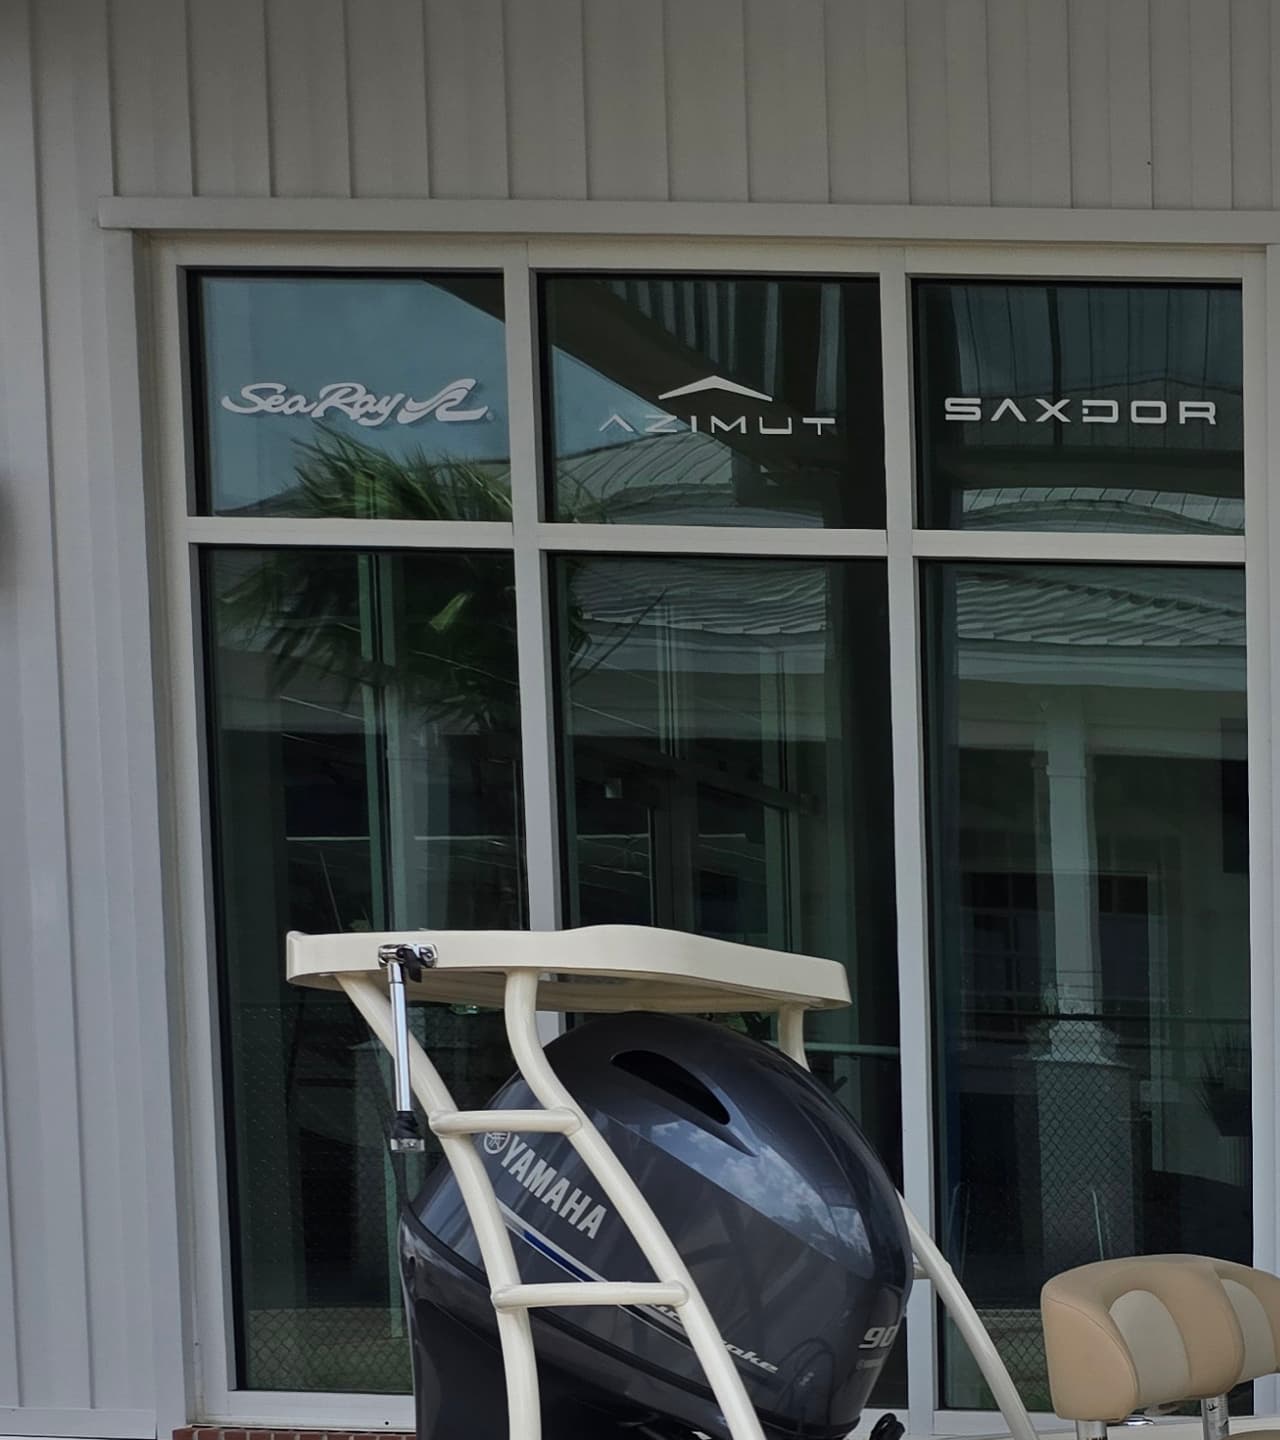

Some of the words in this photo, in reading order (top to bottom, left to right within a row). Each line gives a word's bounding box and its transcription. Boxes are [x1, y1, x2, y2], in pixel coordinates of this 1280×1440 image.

[221, 382, 316, 414] Sea
[311, 382, 405, 427] Ray
[944, 397, 1217, 425] SAXDOR
[599, 414, 836, 436] AZIMUT
[500, 1134, 608, 1240] YAMAHA
[858, 1326, 898, 1349] 90
